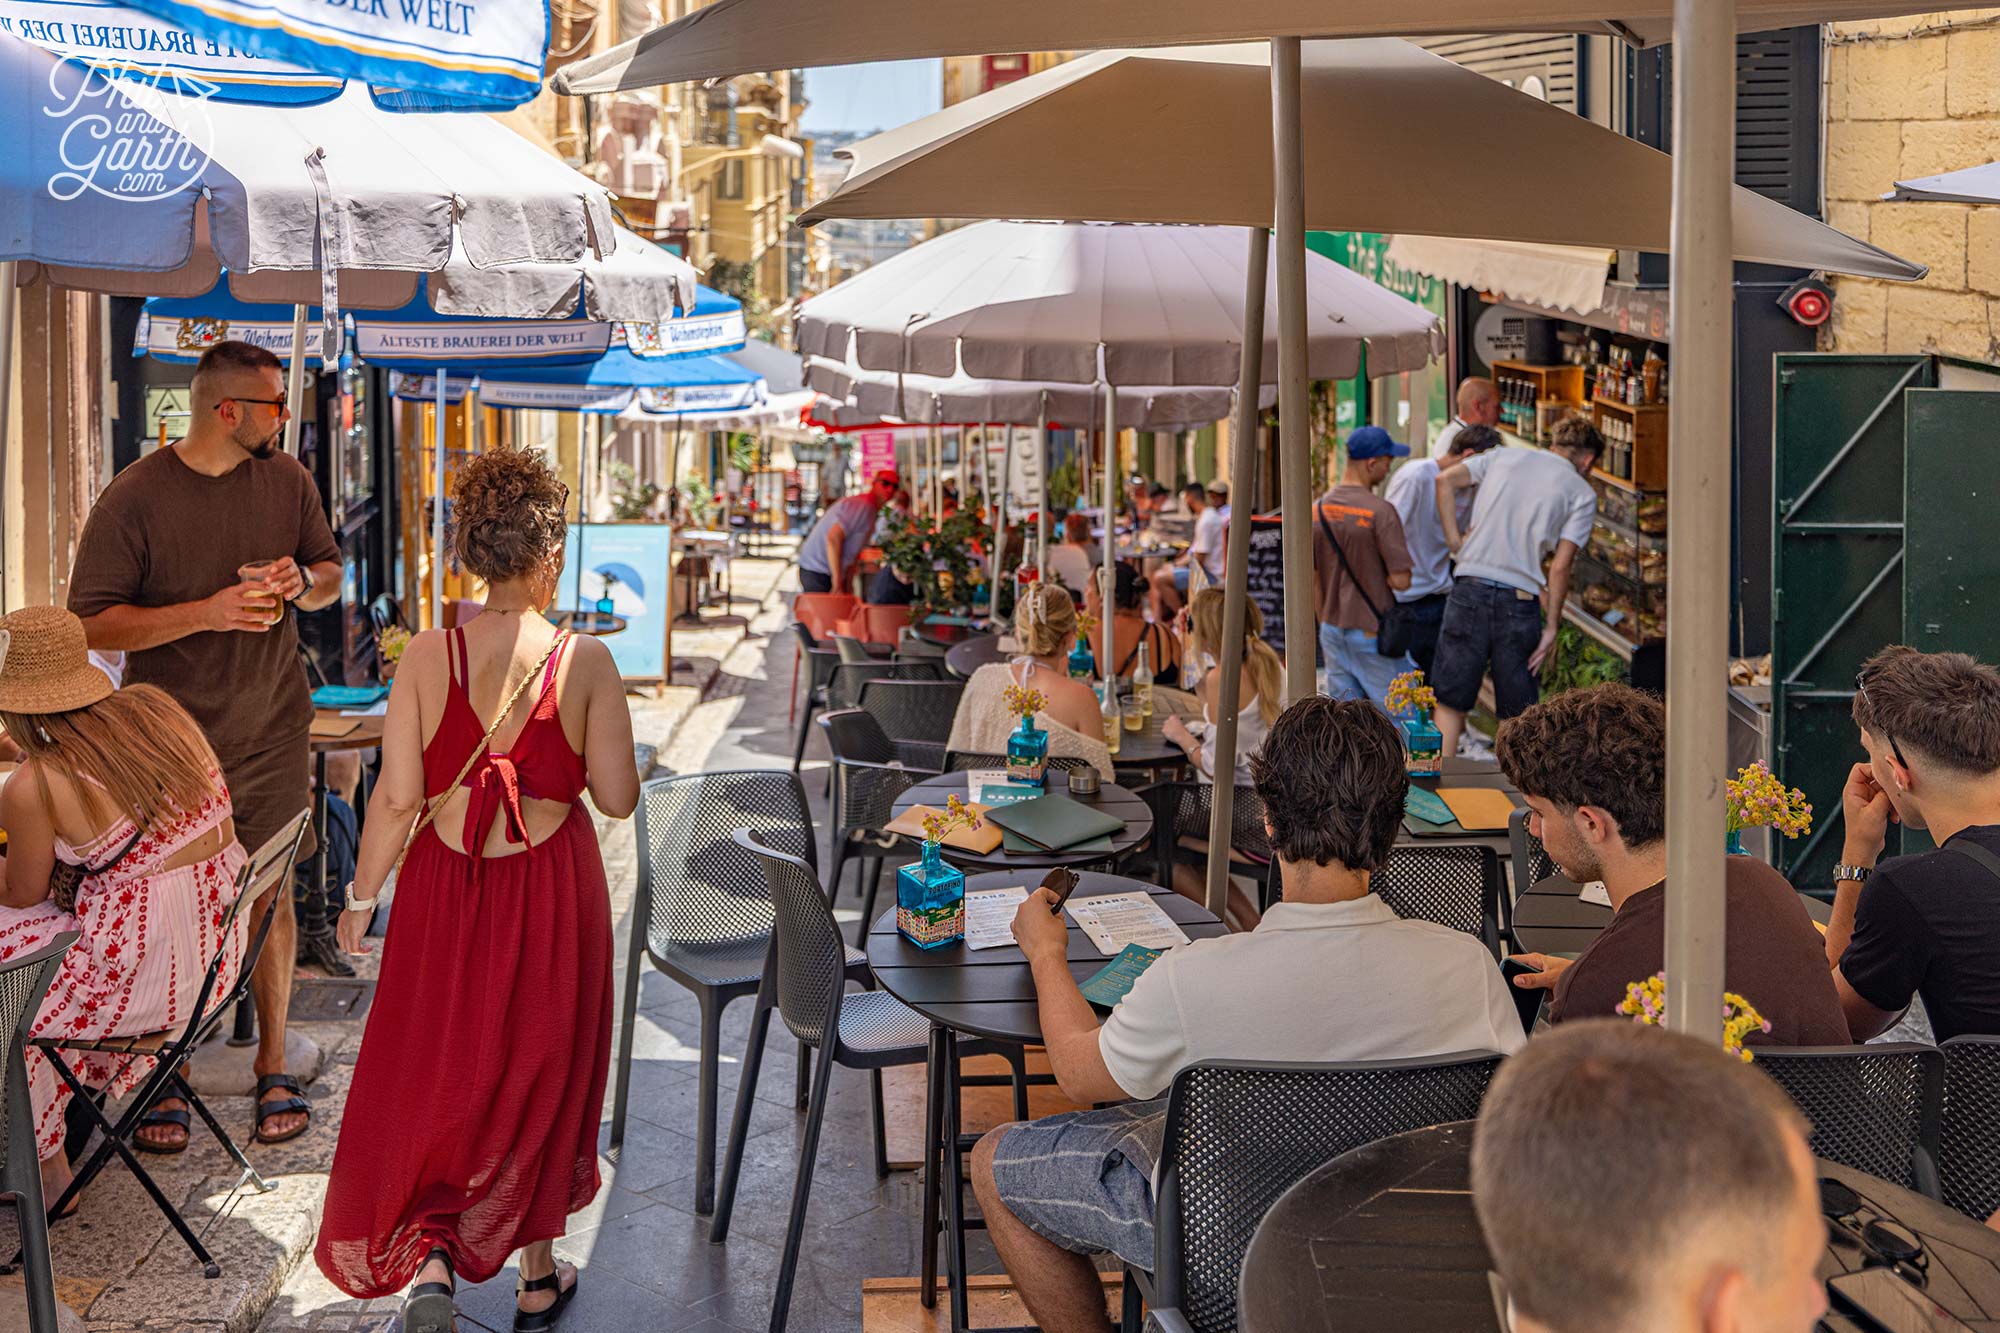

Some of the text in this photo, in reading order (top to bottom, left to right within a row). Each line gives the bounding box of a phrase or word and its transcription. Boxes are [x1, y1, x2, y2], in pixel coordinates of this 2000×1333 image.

[399, 0, 475, 36] WELT
[380, 332, 586, 348] ÄLTESTE BRAUEREI DER WELT
[1087, 897, 1128, 906] GRANO
